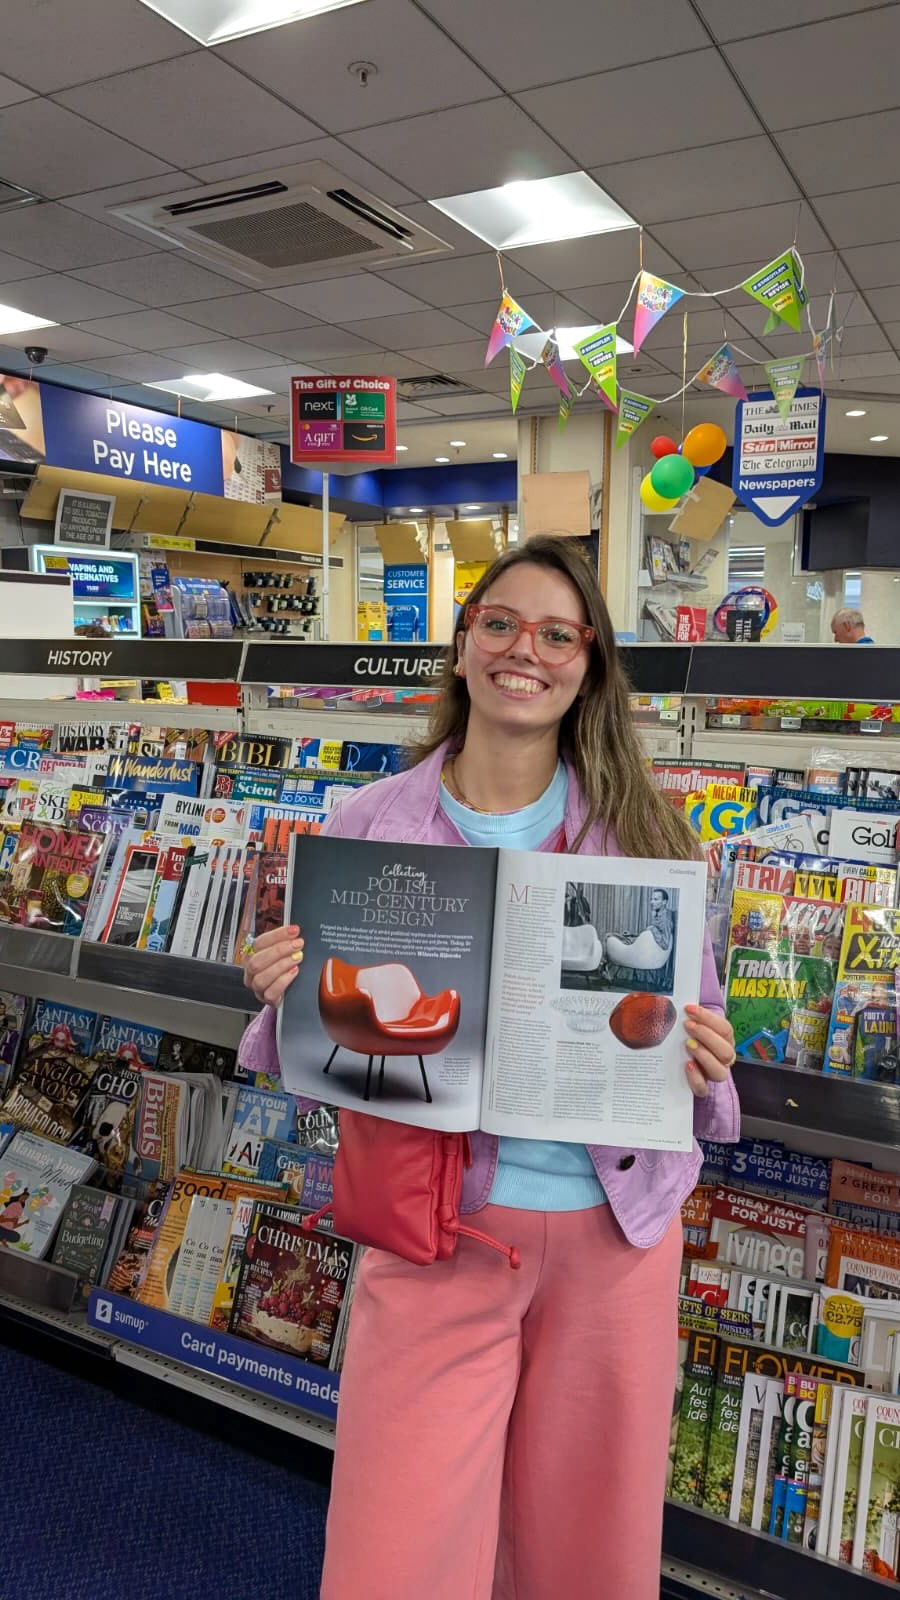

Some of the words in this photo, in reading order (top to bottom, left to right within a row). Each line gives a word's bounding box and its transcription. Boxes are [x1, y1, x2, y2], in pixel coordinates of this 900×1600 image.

[294, 380, 314, 390] The
[316, 379, 337, 389] Gift
[339, 380, 351, 389] of
[353, 379, 390, 390] Choice
[304, 401, 335, 411] next
[744, 407, 766, 416] THE
[106, 409, 177, 448] Please
[744, 424, 775, 435] Daily
[789, 420, 817, 431] Mail
[304, 433, 313, 443] A
[313, 433, 336, 447] GIFT
[780, 440, 815, 450] Mirror
[93, 439, 135, 475] Pay
[143, 451, 192, 482] Here
[742, 460, 761, 471] The
[764, 456, 815, 469] Telegraph
[739, 478, 816, 491] Newspapers
[69, 563, 97, 574] VAPING
[98, 566, 114, 574] AND
[387, 570, 425, 578] CUSTOMER
[387, 579, 425, 589] SERVICE
[679, 614, 690, 625] THE
[678, 623, 691, 635] BEST
[47, 650, 112, 666] HISTORY
[353, 657, 444, 677] CULTURE
[59, 725, 104, 738] HISTORY
[59, 736, 105, 752] WAR
[123, 757, 194, 783] Wanderlust
[712, 785, 737, 801] MEGA
[164, 820, 179, 828] FROM
[179, 823, 200, 836] MAG
[382, 863, 427, 886] Collecting
[366, 876, 437, 896] POLISH
[508, 883, 532, 905] M
[330, 889, 470, 913] MID-CENTURY
[361, 908, 437, 928] DESIGN
[737, 959, 803, 978] TRICKY
[729, 978, 808, 999] MASTER!
[35, 1004, 94, 1029] FANTASY
[100, 1021, 163, 1049] FANTASY
[96, 1072, 139, 1099] GHO
[259, 1095, 288, 1111] YOUR
[141, 1077, 167, 1156] Birds
[731, 1151, 747, 1174] 3
[749, 1155, 788, 1173] GREAT
[791, 1161, 829, 1179] MAGA
[757, 1168, 782, 1182] FOR
[785, 1173, 816, 1189] JUST
[840, 1176, 848, 1185] 2
[852, 1181, 892, 1194] GREAT
[172, 1180, 225, 1201] good
[863, 1191, 890, 1205] FOR
[715, 1190, 725, 1200] 2
[727, 1193, 770, 1213] GREAT
[774, 1205, 805, 1221] MAG
[731, 1205, 759, 1223] FOR
[761, 1214, 795, 1232] JUST
[797, 1224, 806, 1234] £
[61, 1230, 105, 1249] Budgeting
[258, 1225, 350, 1269] CHRISTMAS
[316, 1263, 347, 1281] FOOD
[704, 1305, 719, 1318] OF
[720, 1308, 750, 1324] SEEDS
[829, 1300, 861, 1316] SAVE
[114, 1310, 146, 1333] sumup
[825, 1310, 862, 1328] £2.75
[719, 1323, 752, 1336] INSIDE
[180, 1332, 215, 1358] Card
[217, 1349, 293, 1387] payments
[296, 1374, 340, 1403] made
[689, 1394, 708, 1409] fes
[687, 1408, 708, 1422] ide
[719, 1406, 739, 1420] fes
[718, 1419, 738, 1433] ide
